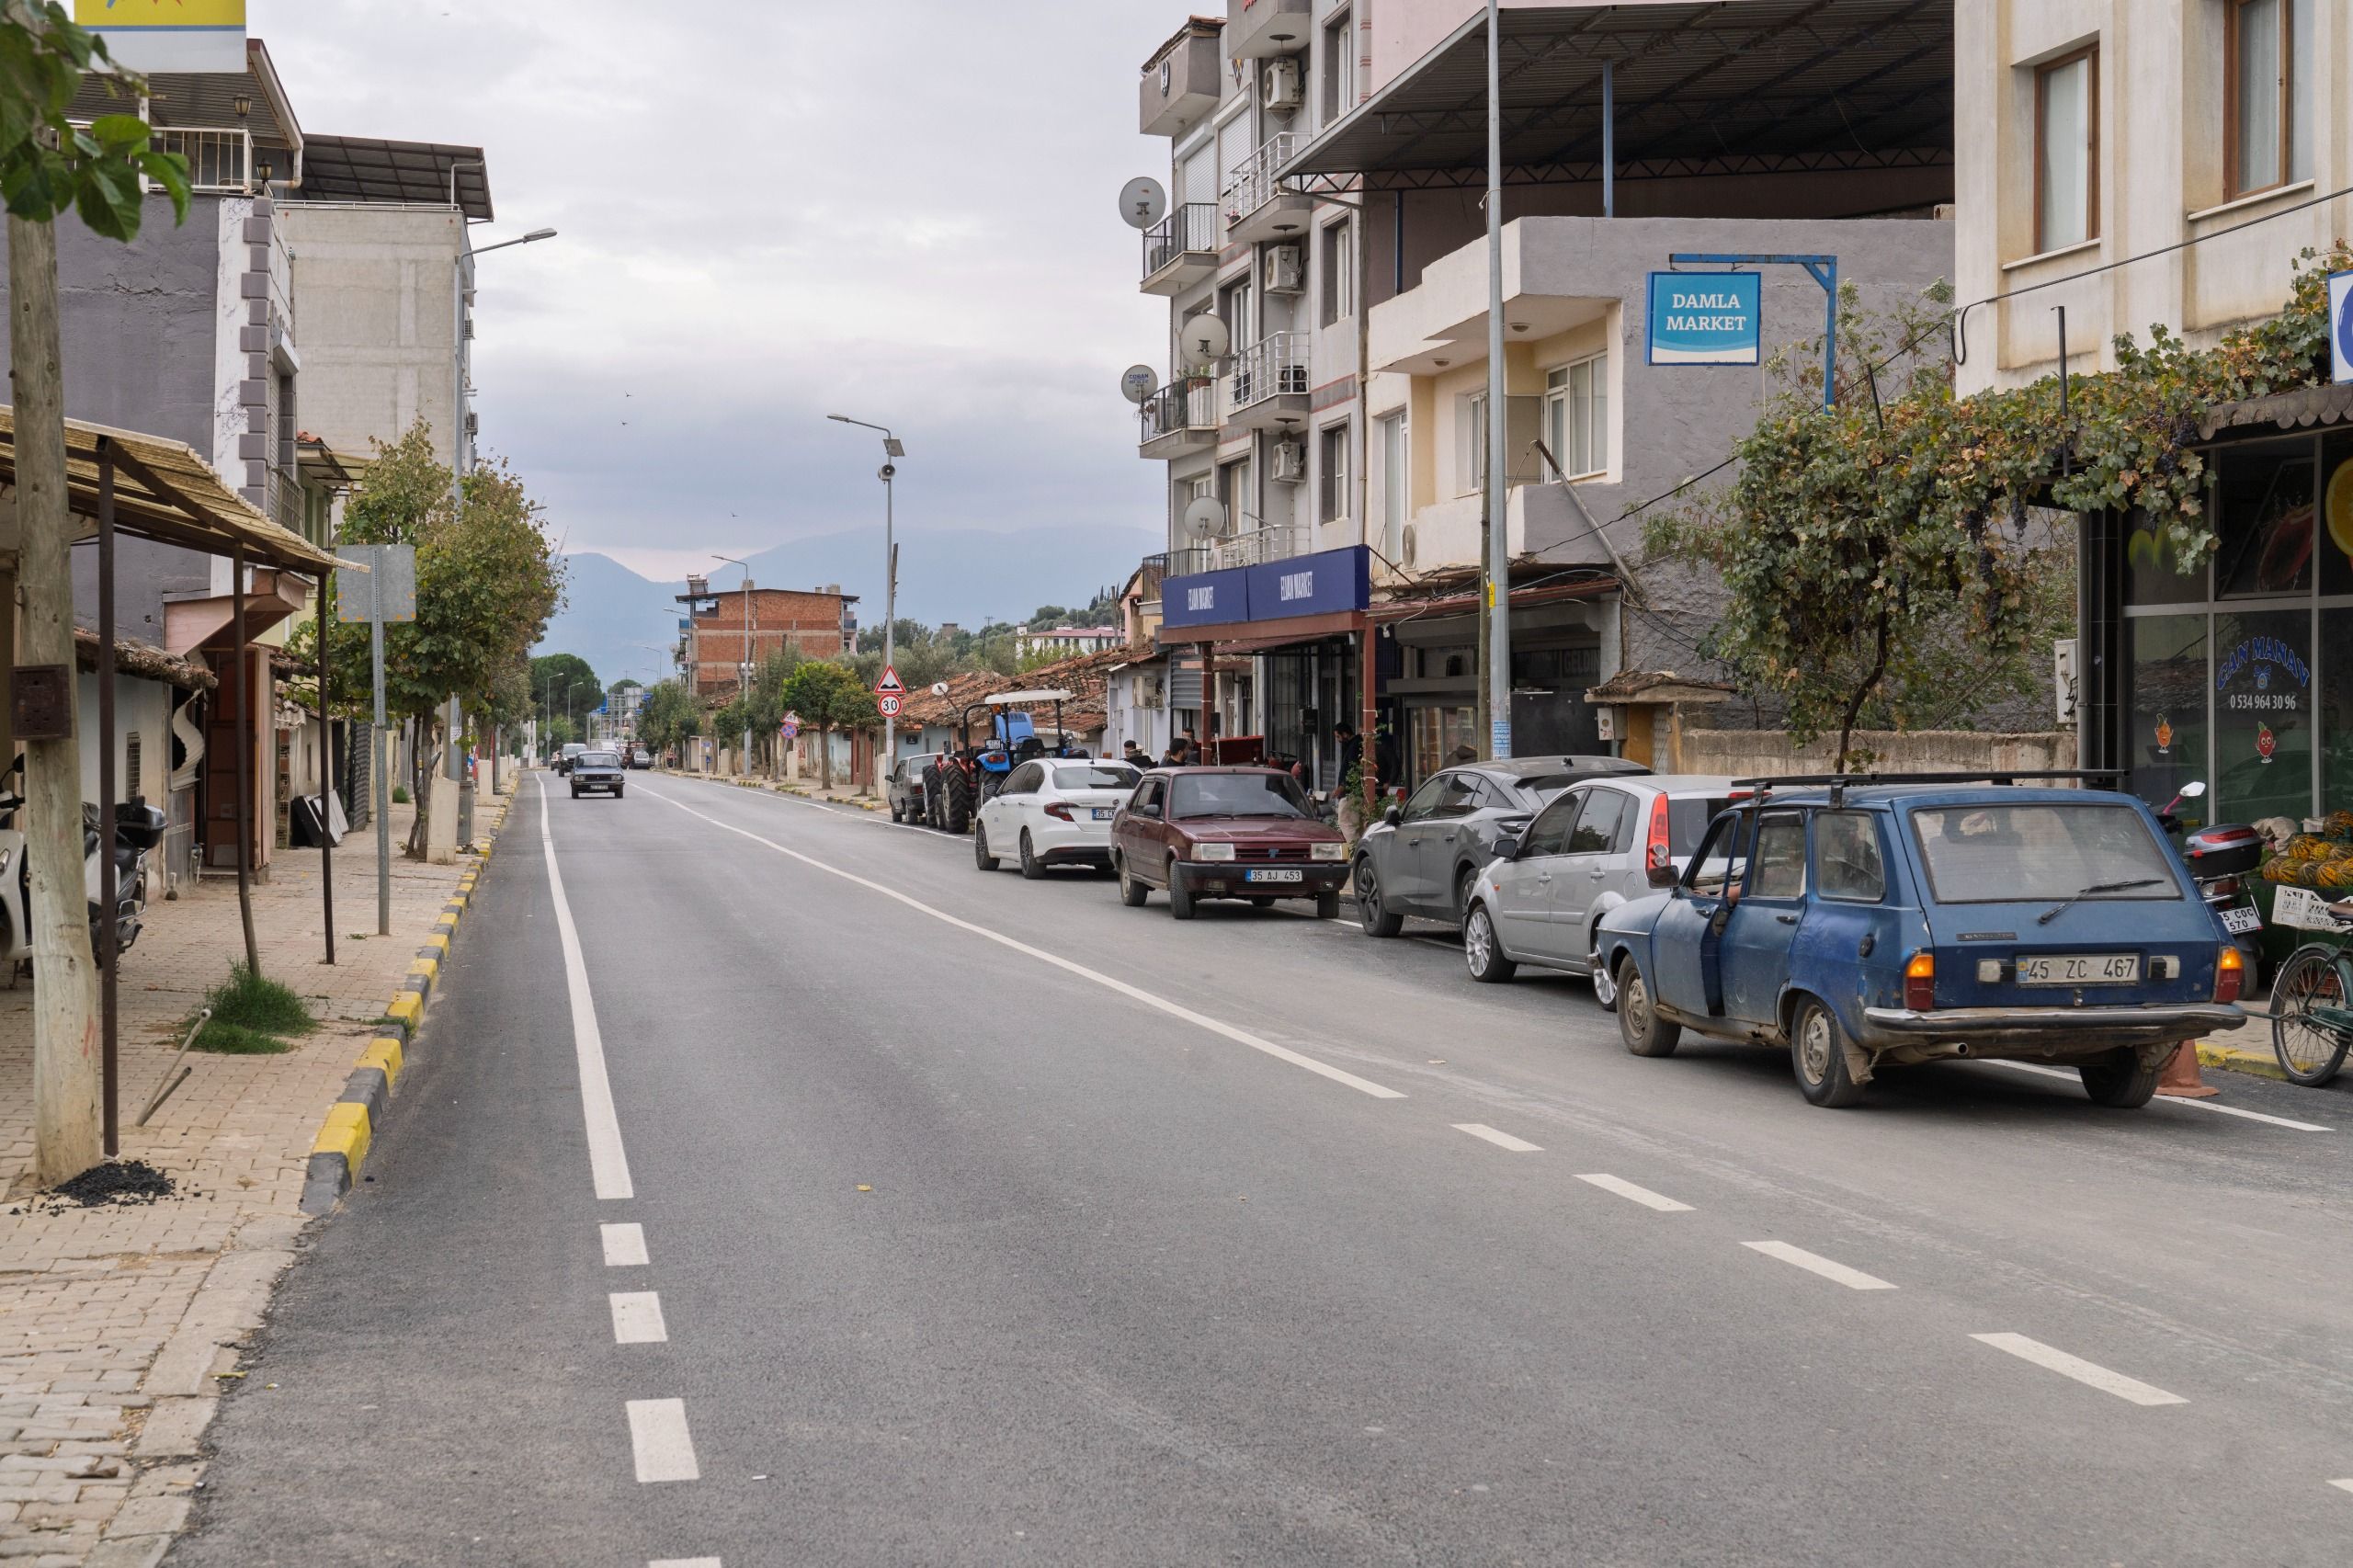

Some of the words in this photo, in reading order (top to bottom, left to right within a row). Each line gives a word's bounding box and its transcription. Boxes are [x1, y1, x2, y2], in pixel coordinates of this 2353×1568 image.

[1672, 293, 1741, 309] DAMLA
[1665, 315, 1746, 331] MARKET
[1293, 571, 1313, 599] MARKET
[1199, 585, 1214, 609] MARKET
[2217, 640, 2250, 690] CAN
[2252, 636, 2310, 687] MANAV
[883, 699, 898, 711] 30
[2230, 694, 2236, 709] 0
[2237, 694, 2254, 709] 534
[2255, 694, 2271, 709] 964
[2272, 694, 2284, 710] 30
[2285, 694, 2297, 710] 96
[1097, 810, 1105, 818] 35
[1252, 870, 1263, 881] 35
[1267, 870, 1278, 881] AJ
[1284, 870, 1301, 881] 453
[2234, 908, 2254, 918] COC
[2229, 919, 2248, 930] 570
[2028, 960, 2050, 980] 45
[2065, 960, 2087, 979] ZC
[2103, 958, 2135, 978] 467
